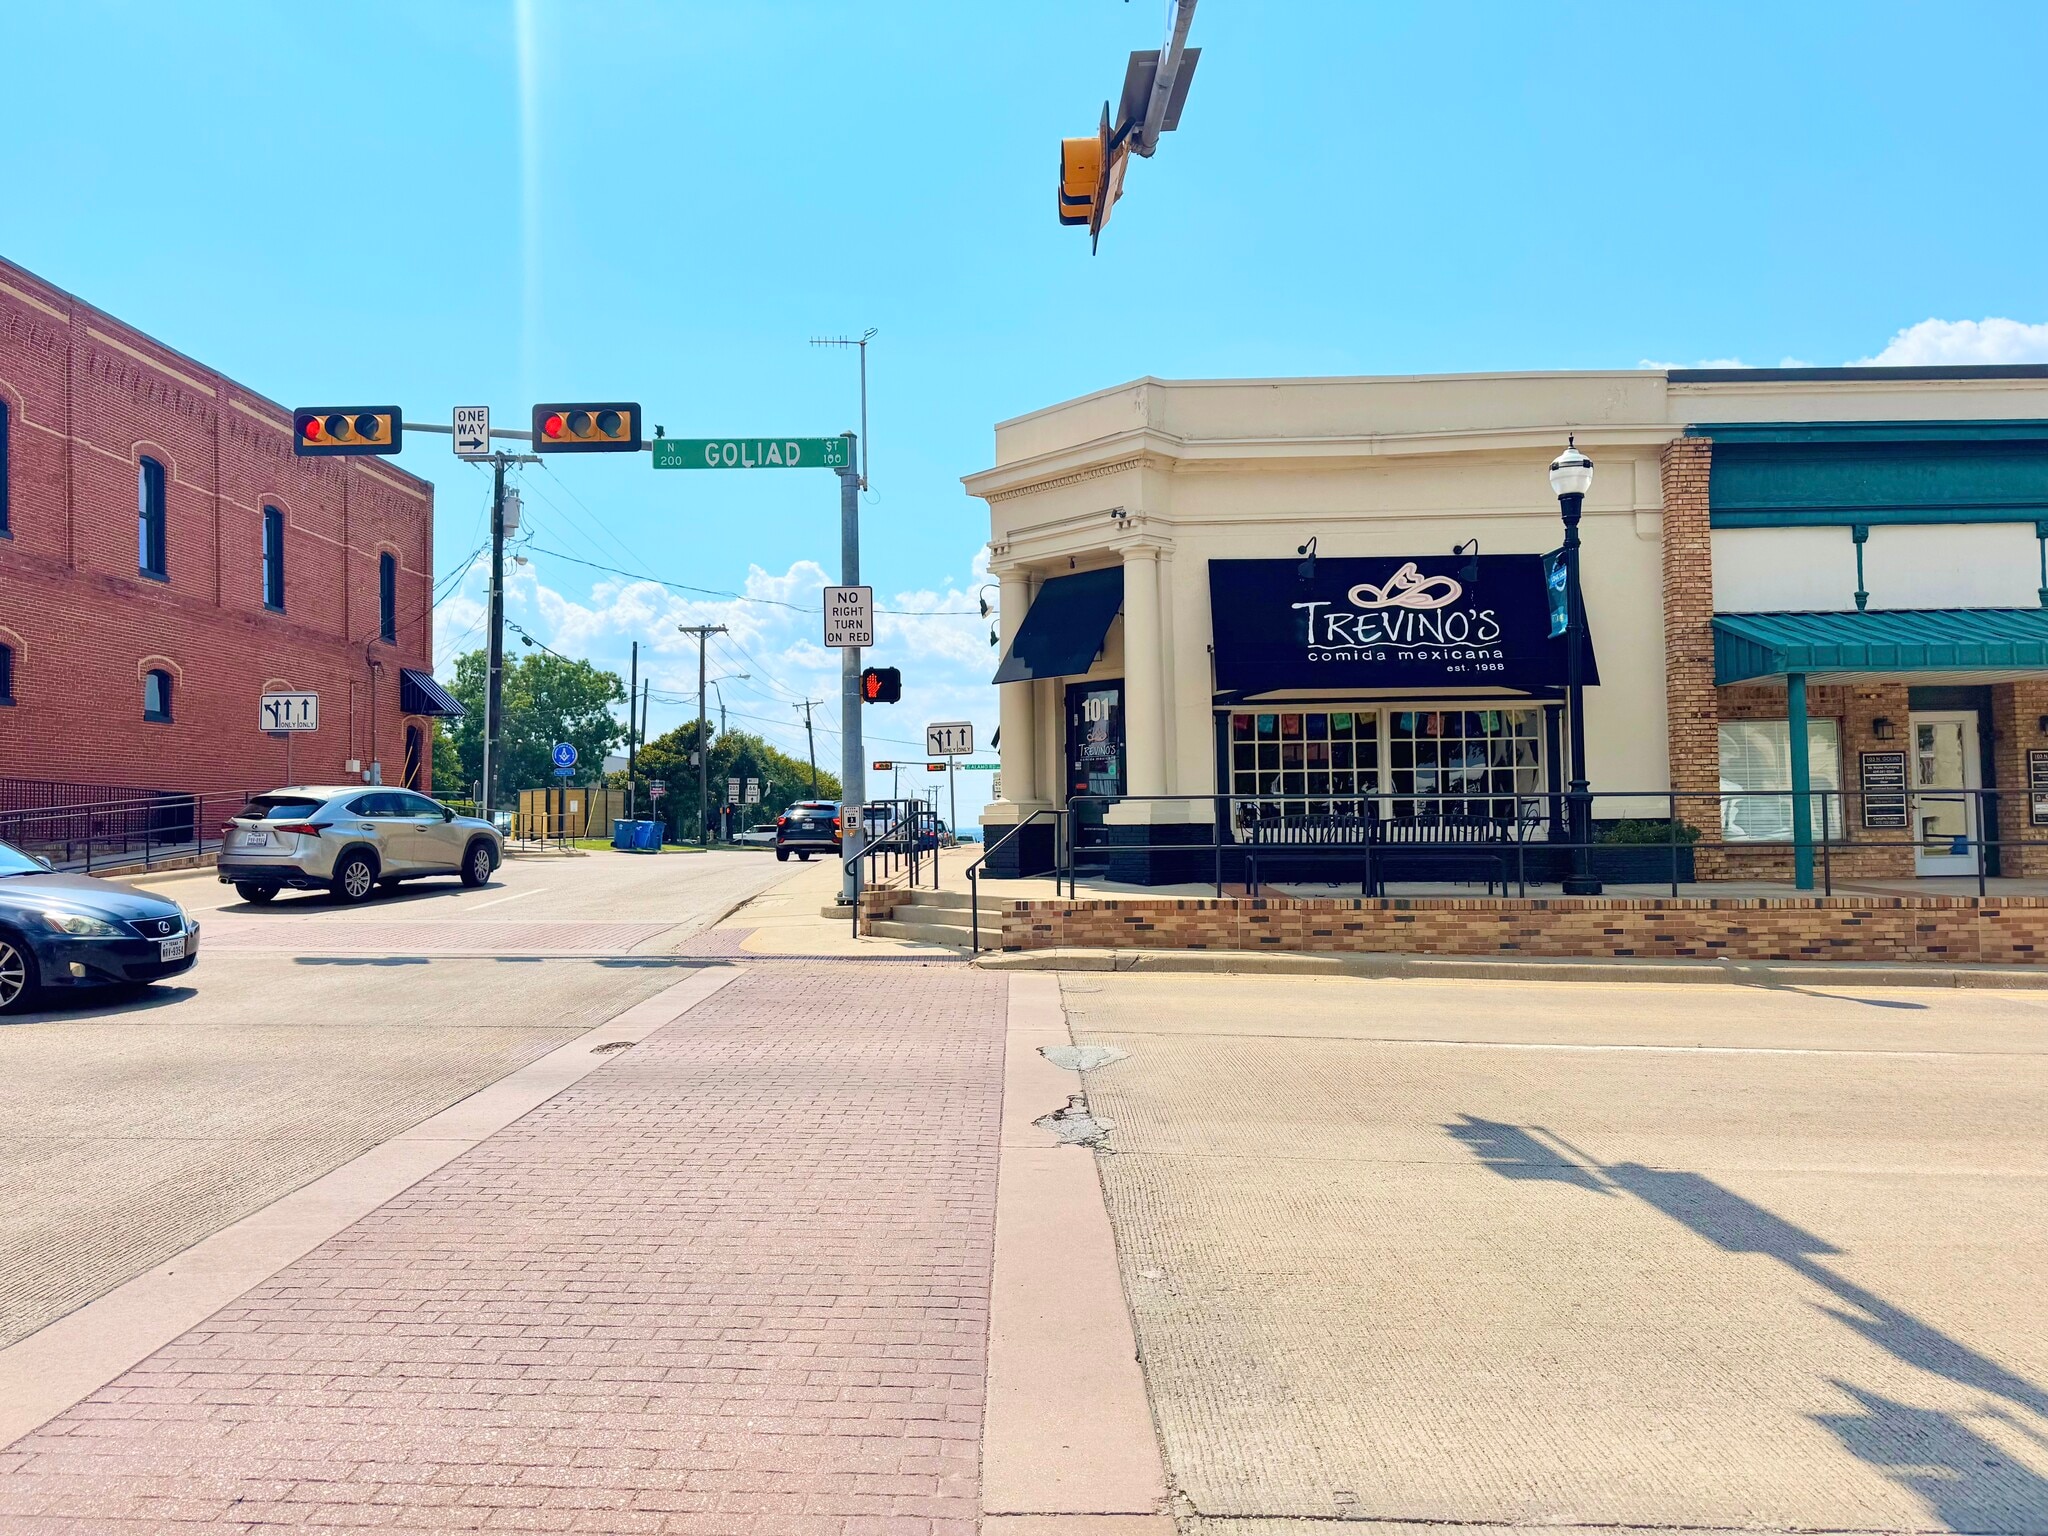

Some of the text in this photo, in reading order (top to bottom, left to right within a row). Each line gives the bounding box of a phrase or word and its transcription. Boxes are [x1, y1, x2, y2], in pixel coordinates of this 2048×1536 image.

[458, 411, 485, 422] ONE
[458, 424, 485, 435] WAY
[667, 443, 675, 453] N
[825, 441, 839, 453] ST
[704, 442, 801, 467] GOLIAD
[823, 454, 842, 465] 100
[660, 456, 682, 467] 200
[837, 592, 858, 604] NO
[832, 607, 864, 617] RIGHT
[835, 620, 863, 630] TURN
[1291, 601, 1500, 645] TREVINO'S
[827, 632, 870, 642] ON RED
[1307, 649, 1503, 662] comida mexicana
[1446, 663, 1505, 672] est. 1988
[1082, 698, 1109, 722] 101
